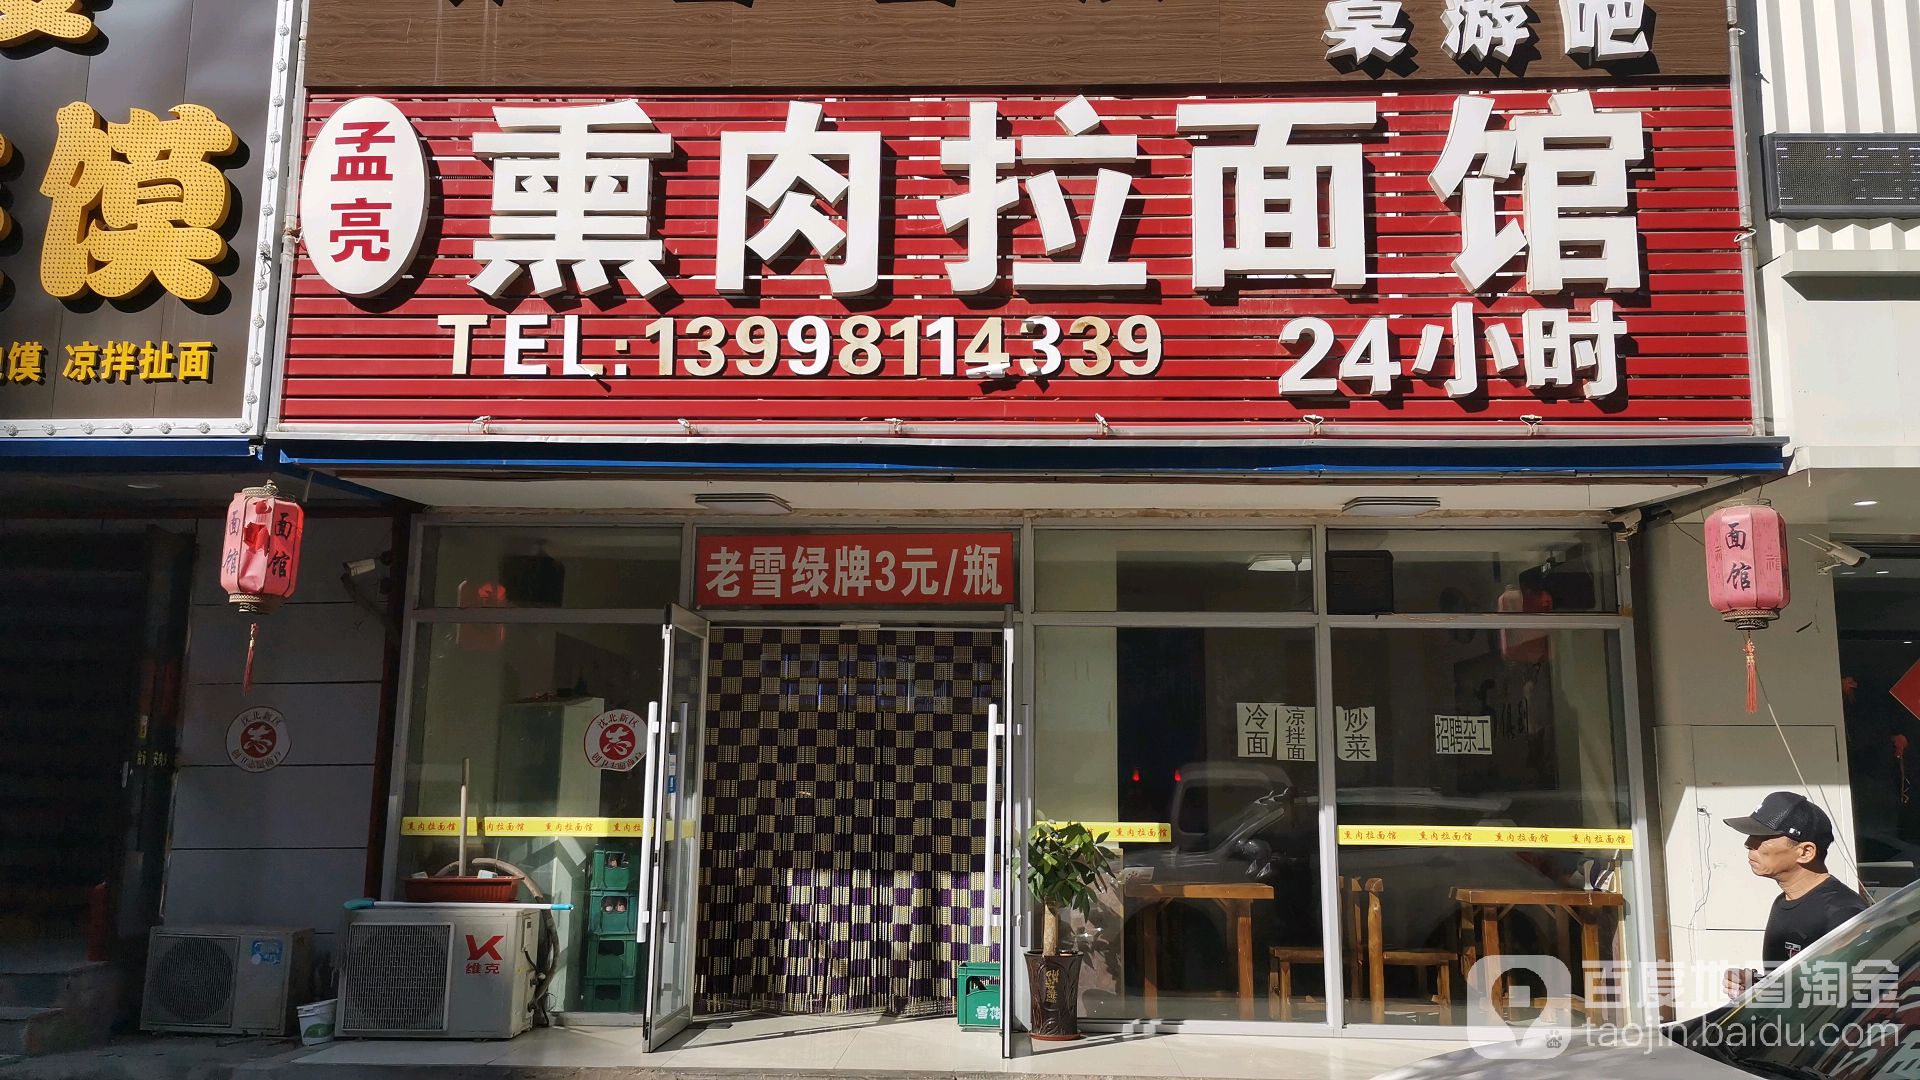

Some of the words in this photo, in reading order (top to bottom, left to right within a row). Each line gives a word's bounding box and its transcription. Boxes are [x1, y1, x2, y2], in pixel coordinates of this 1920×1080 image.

[330, 121, 396, 263] 孟亮
[468, 90, 1645, 297] 熏肉拉面馆
[0, 341, 44, 382] 馍
[62, 341, 214, 382] 凉拌扯面
[1278, 300, 1628, 399] 24小时
[222, 509, 241, 575] 面馆
[267, 512, 293, 578] 面馆
[1724, 522, 1752, 592] 面馆
[705, 544, 1003, 598] 老雪绿牌3元/瓶
[1245, 704, 1270, 756] 冷面
[1285, 706, 1307, 761] 凉拌面
[1344, 707, 1371, 760] 炒菜
[1435, 715, 1491, 754] 招聘杂工
[465, 962, 500, 974] 维克
